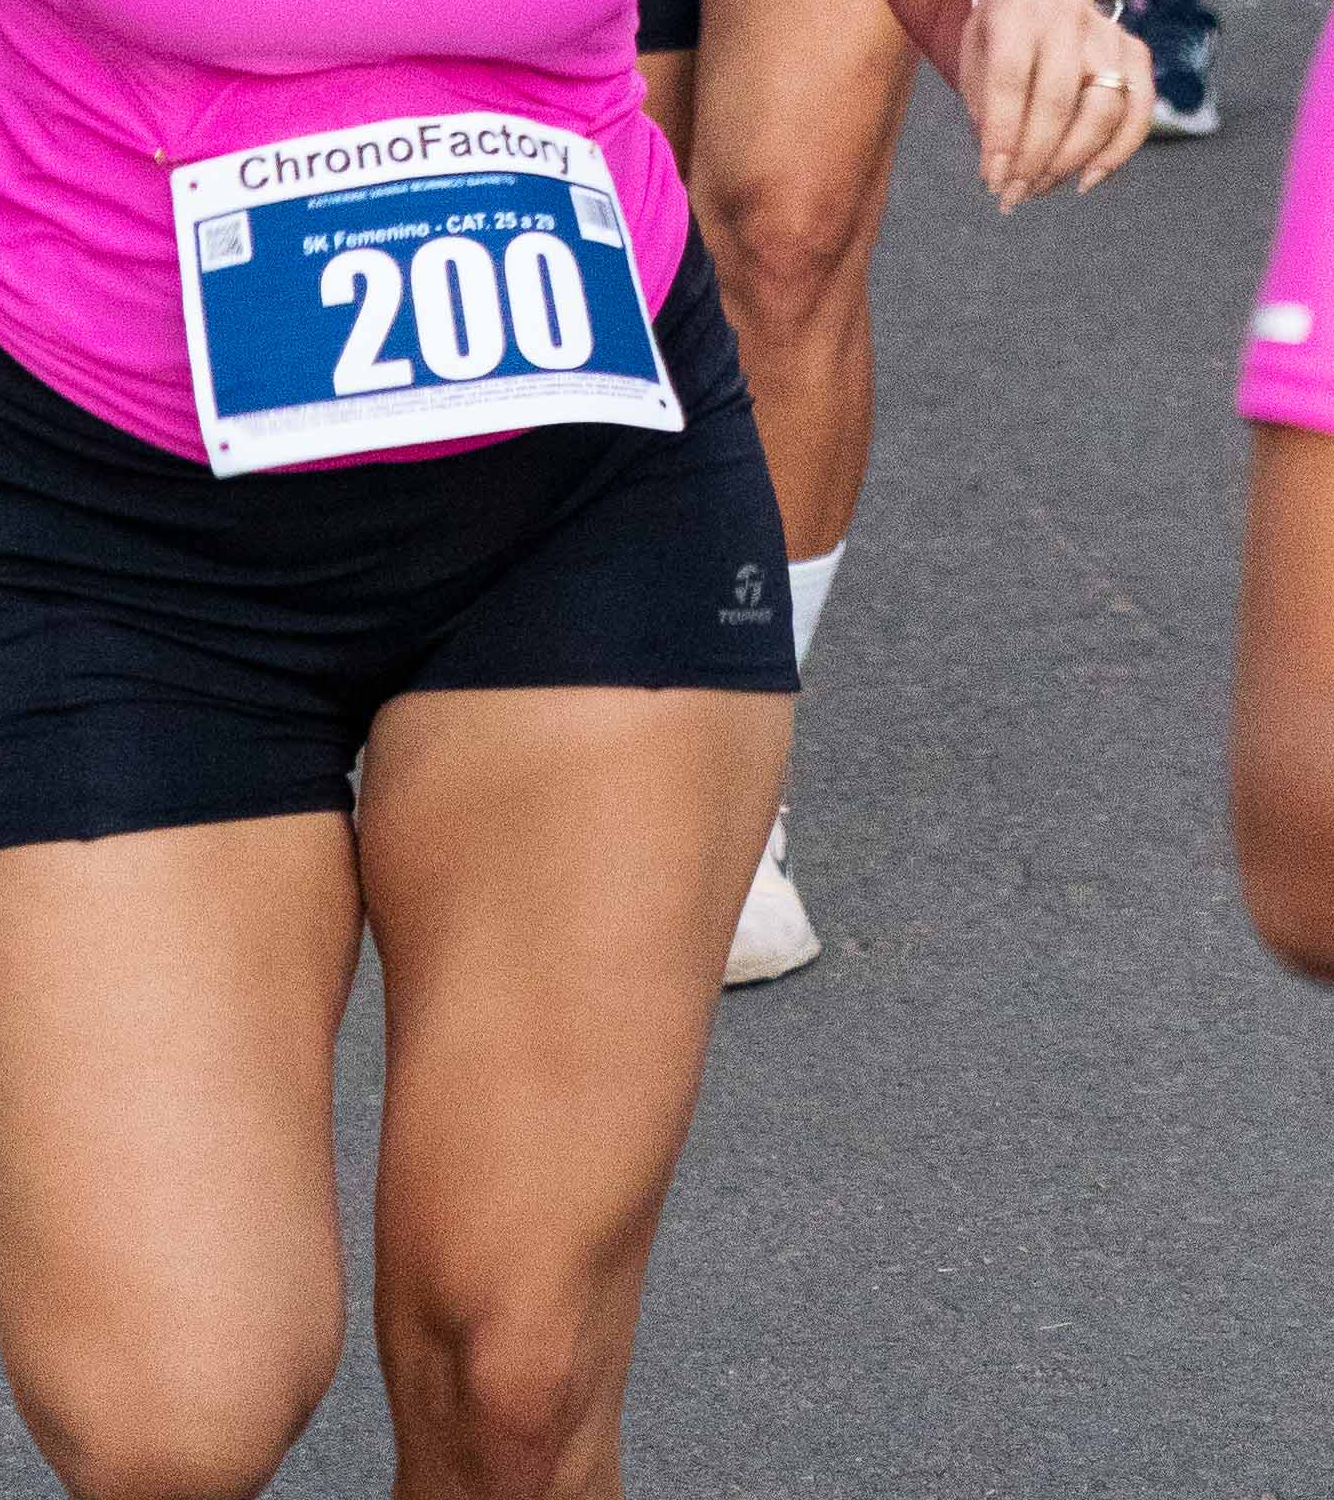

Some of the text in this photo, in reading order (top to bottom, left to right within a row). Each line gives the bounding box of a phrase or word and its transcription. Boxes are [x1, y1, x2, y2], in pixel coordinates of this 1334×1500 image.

[238, 123, 571, 191] ChronoFactory
[333, 222, 430, 251] Femenino
[320, 230, 596, 397] 200
